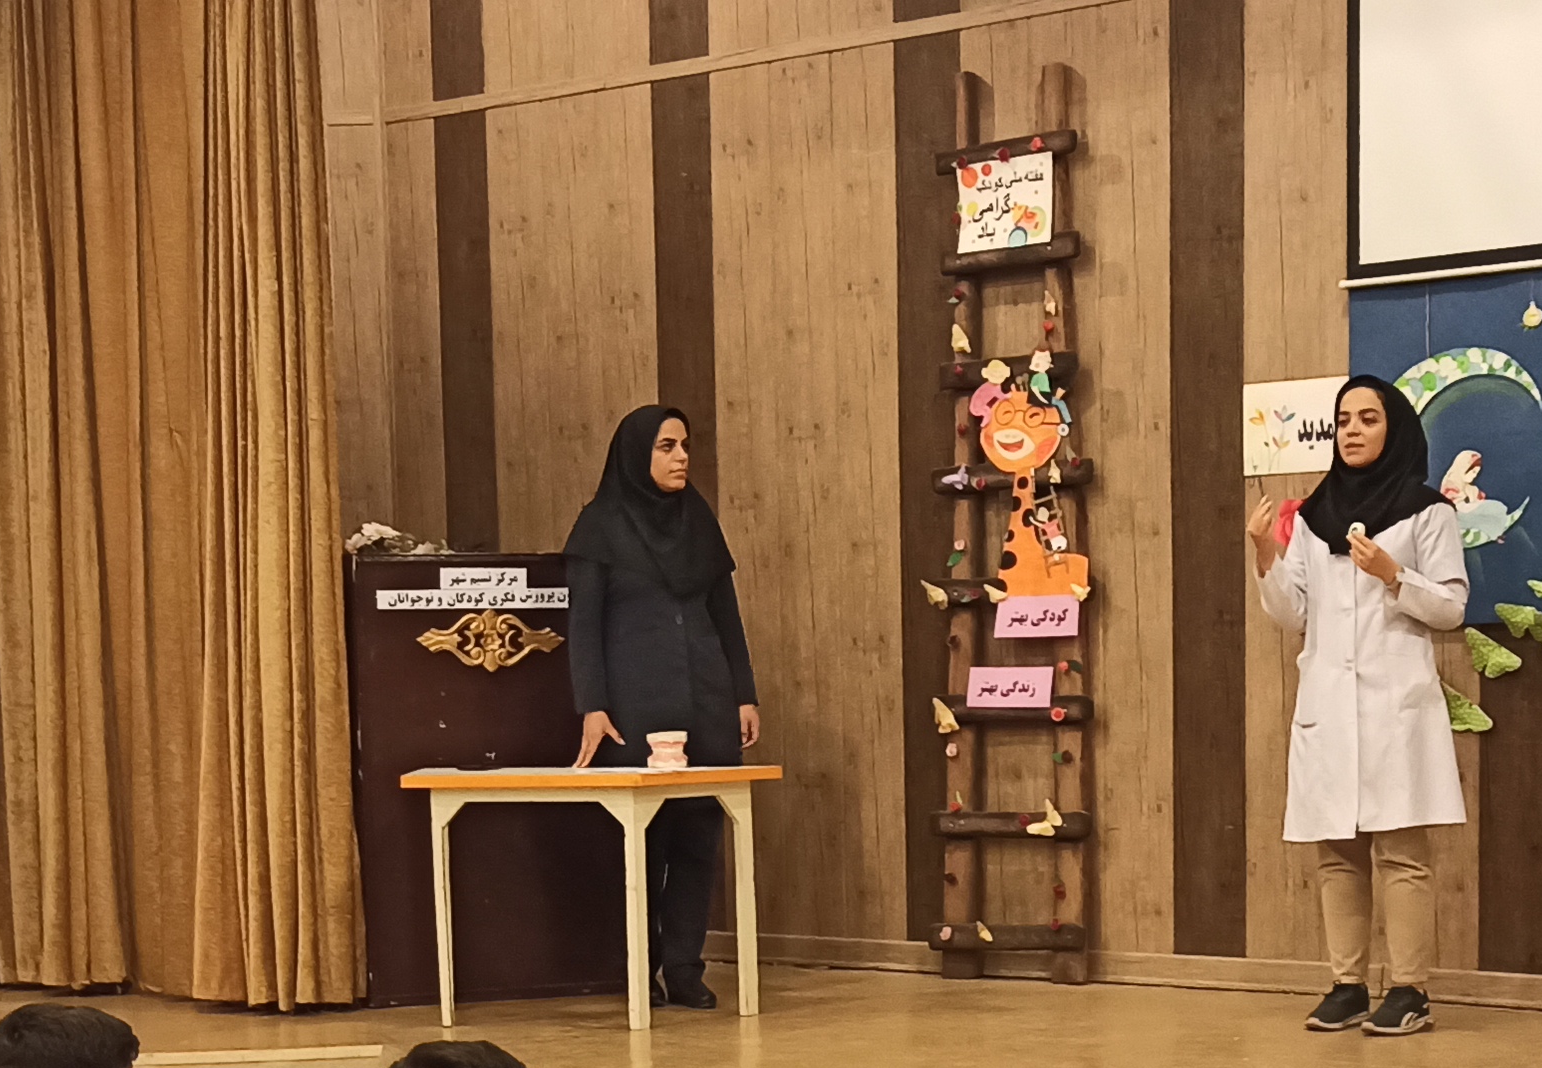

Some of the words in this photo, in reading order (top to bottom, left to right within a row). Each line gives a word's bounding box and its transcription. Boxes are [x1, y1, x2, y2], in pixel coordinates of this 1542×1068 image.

[1005, 171, 1023, 189] ملی
[972, 193, 1011, 223] گرامی
[449, 573, 467, 587] شهر
[470, 574, 492, 586] نسیم
[495, 572, 519, 586] مرکز
[387, 593, 434, 608] نوجوانان
[437, 596, 443, 607] و
[447, 592, 485, 607] کودکان
[488, 591, 516, 607] فکری
[1007, 611, 1029, 628] بهتر
[1031, 608, 1069, 627] کودکی
[976, 681, 999, 698] بهتر
[1000, 680, 1037, 698] زندگی
